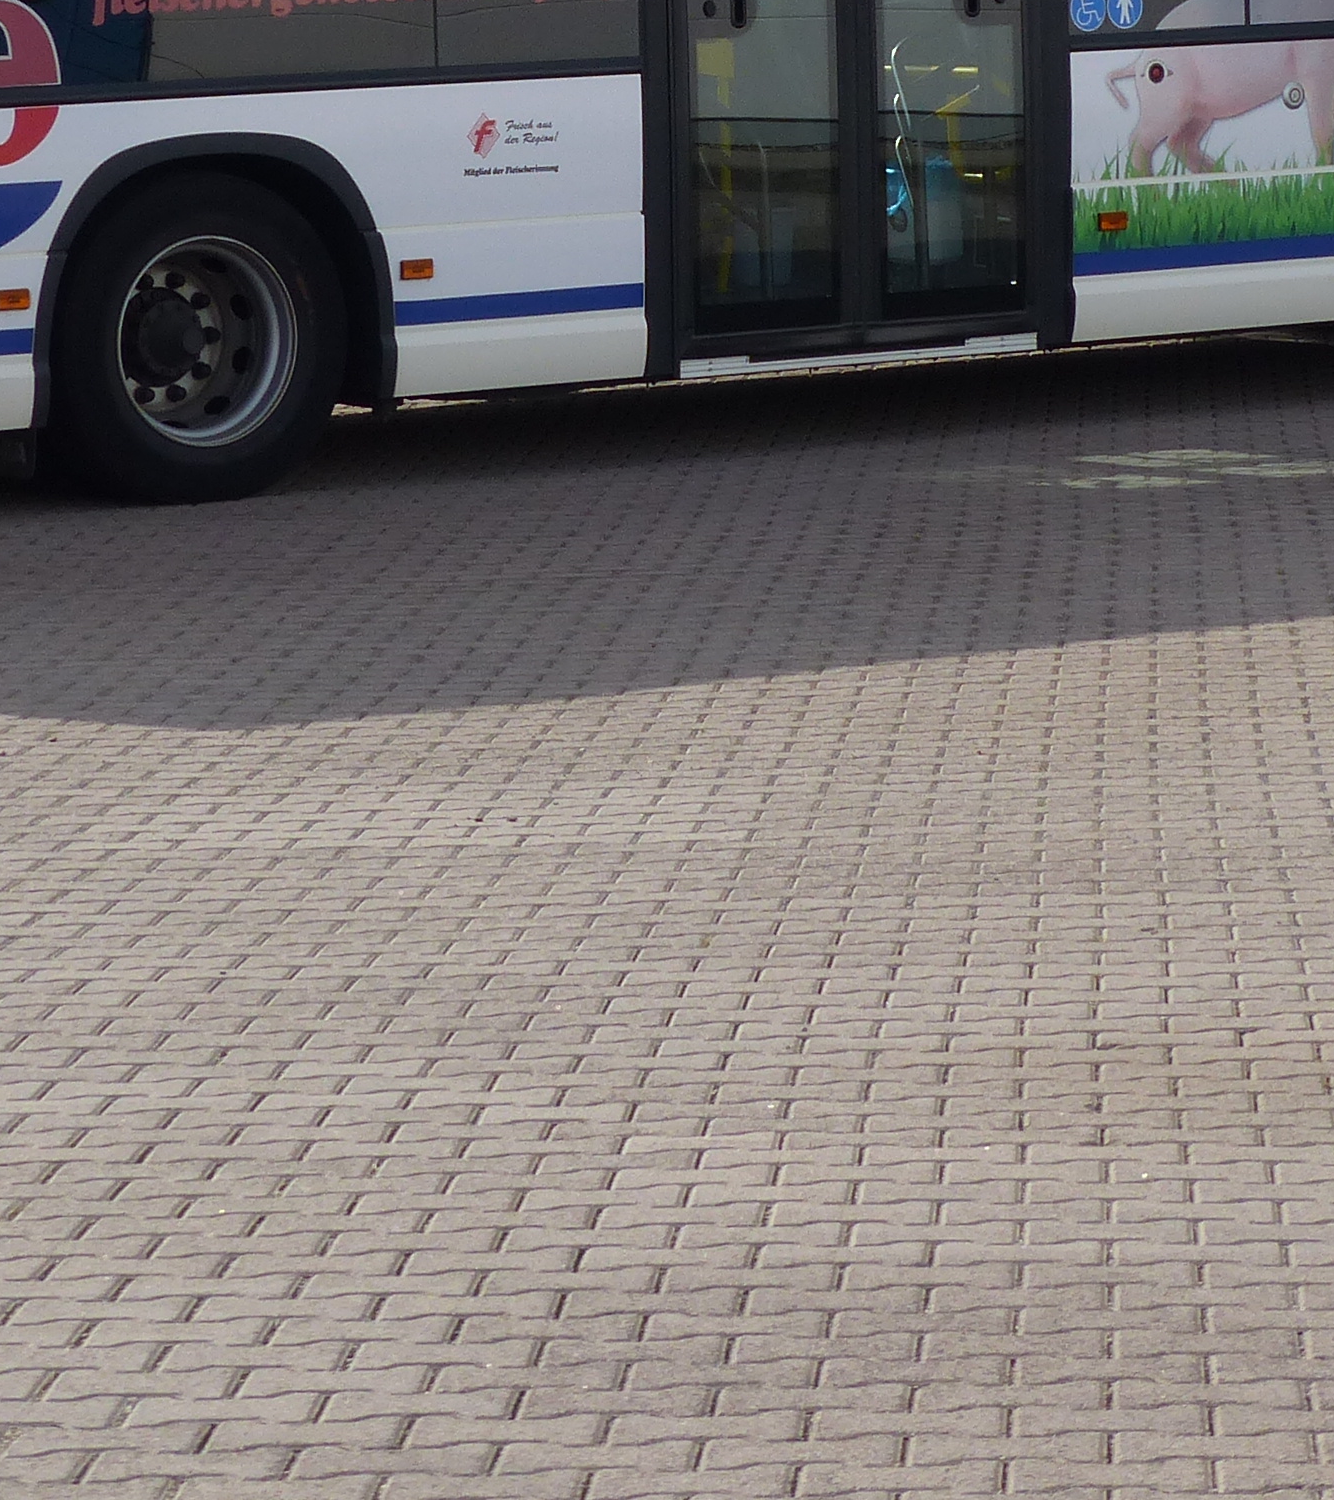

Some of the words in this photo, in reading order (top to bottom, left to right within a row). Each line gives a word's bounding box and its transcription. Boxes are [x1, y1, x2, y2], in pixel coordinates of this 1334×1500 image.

[504, 118, 534, 132] Frisch
[536, 121, 553, 130] aus
[504, 133, 520, 145] der
[522, 131, 560, 146] Region!
[463, 165, 492, 177] Mitglied
[492, 166, 505, 175] der
